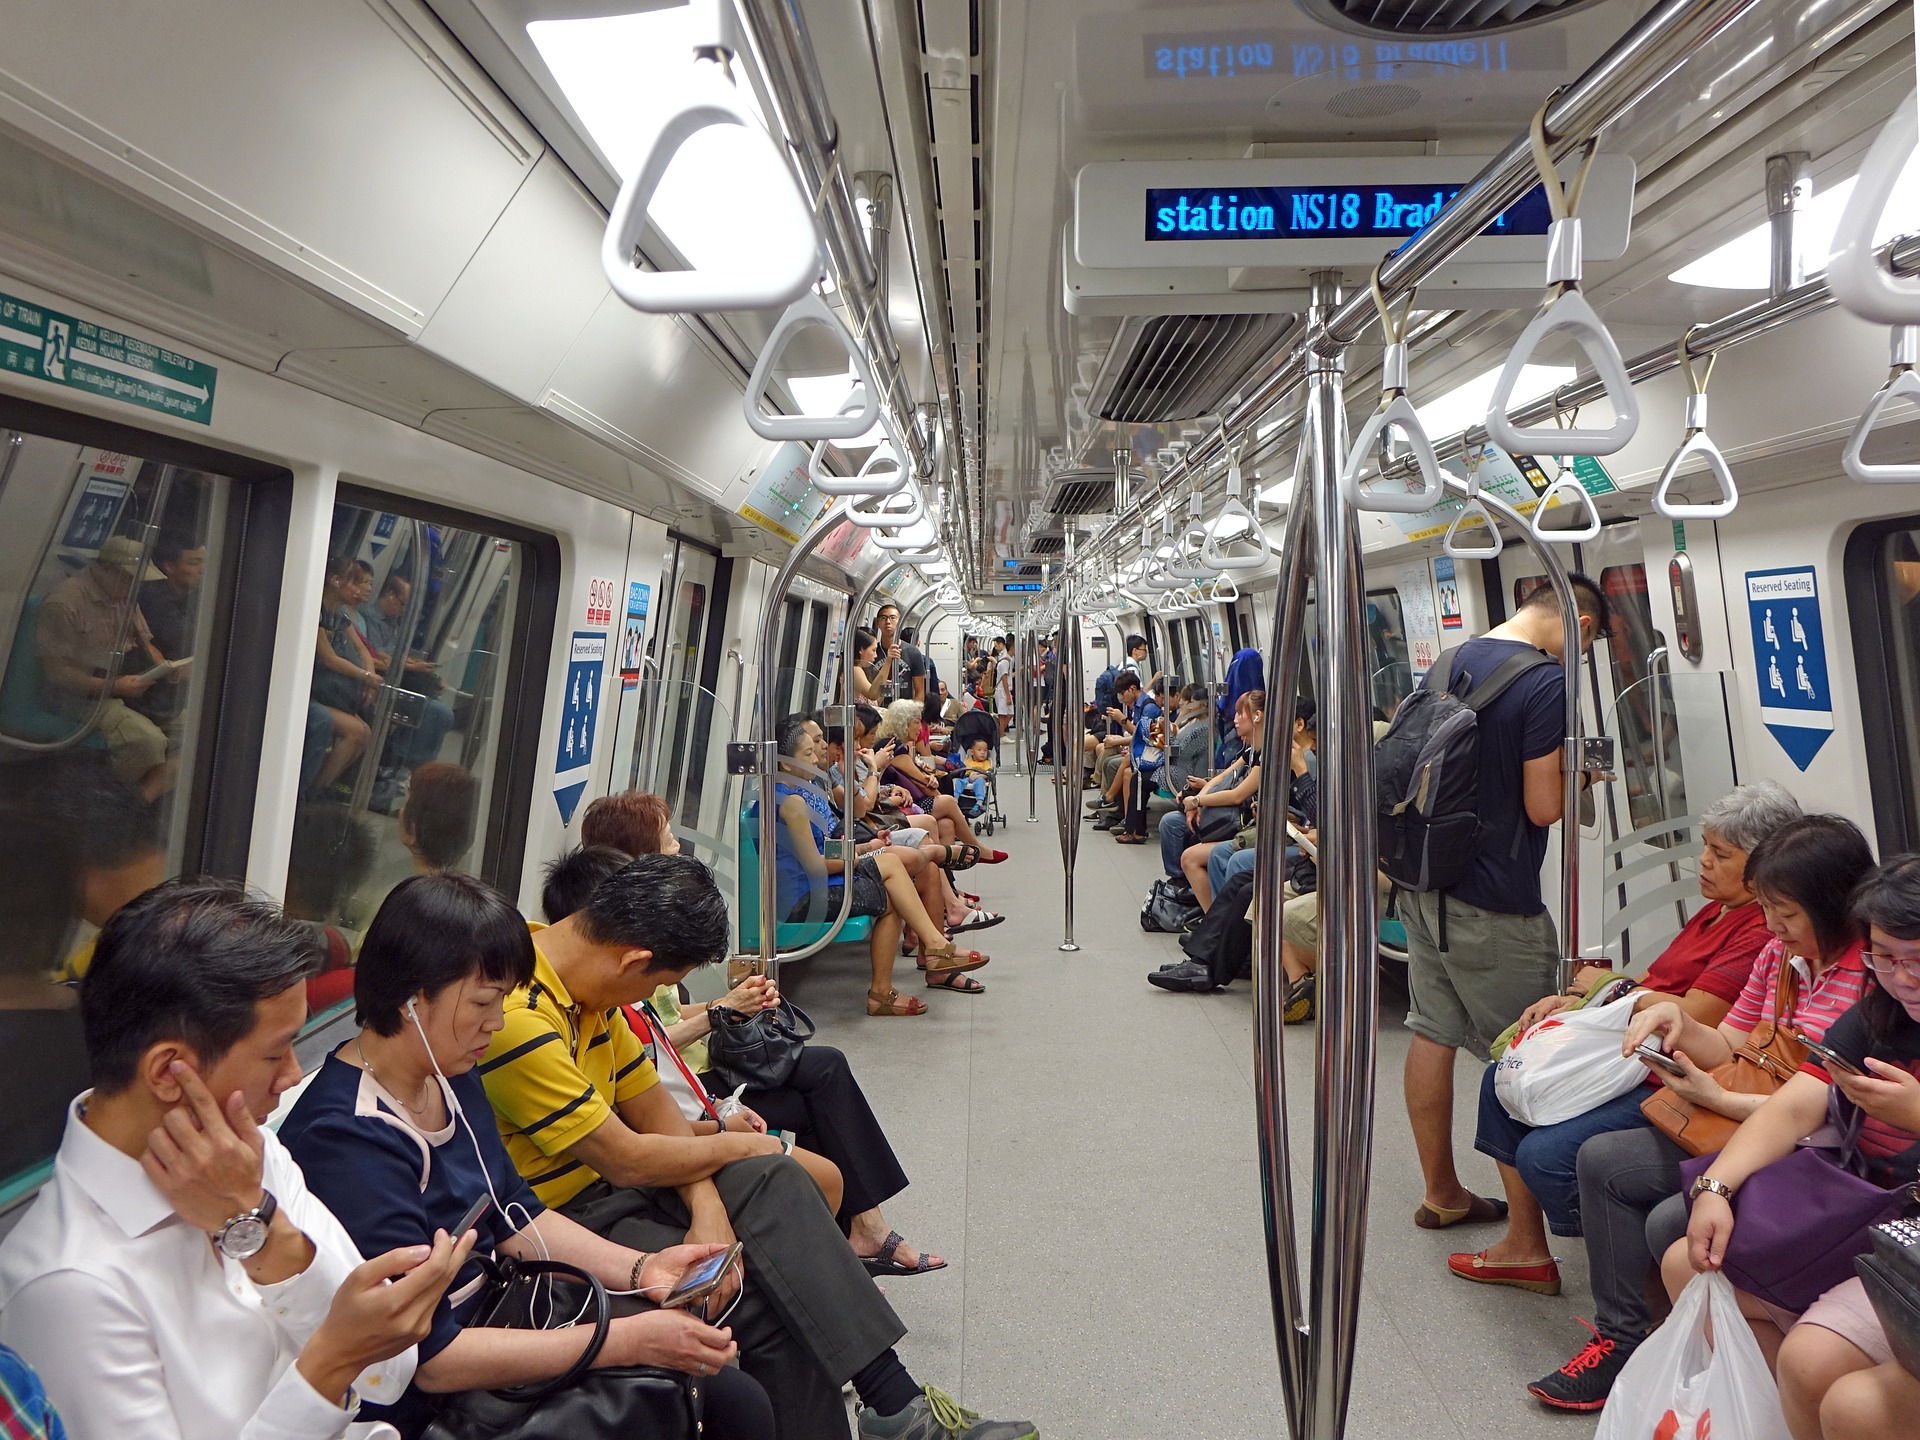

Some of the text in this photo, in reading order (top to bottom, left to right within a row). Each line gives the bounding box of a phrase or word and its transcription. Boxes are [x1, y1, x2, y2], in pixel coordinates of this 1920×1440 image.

[1156, 195, 1275, 231] station
[1290, 193, 1360, 229] NS18
[3, 301, 17, 318] OF
[18, 306, 42, 327] TRAIN
[78, 321, 97, 338] PINTU
[99, 327, 124, 346] KELUAR
[76, 336, 97, 352] KEDUA
[1752, 578, 1811, 593] Reserved Seating
[575, 642, 603, 656] Reserved Seating
